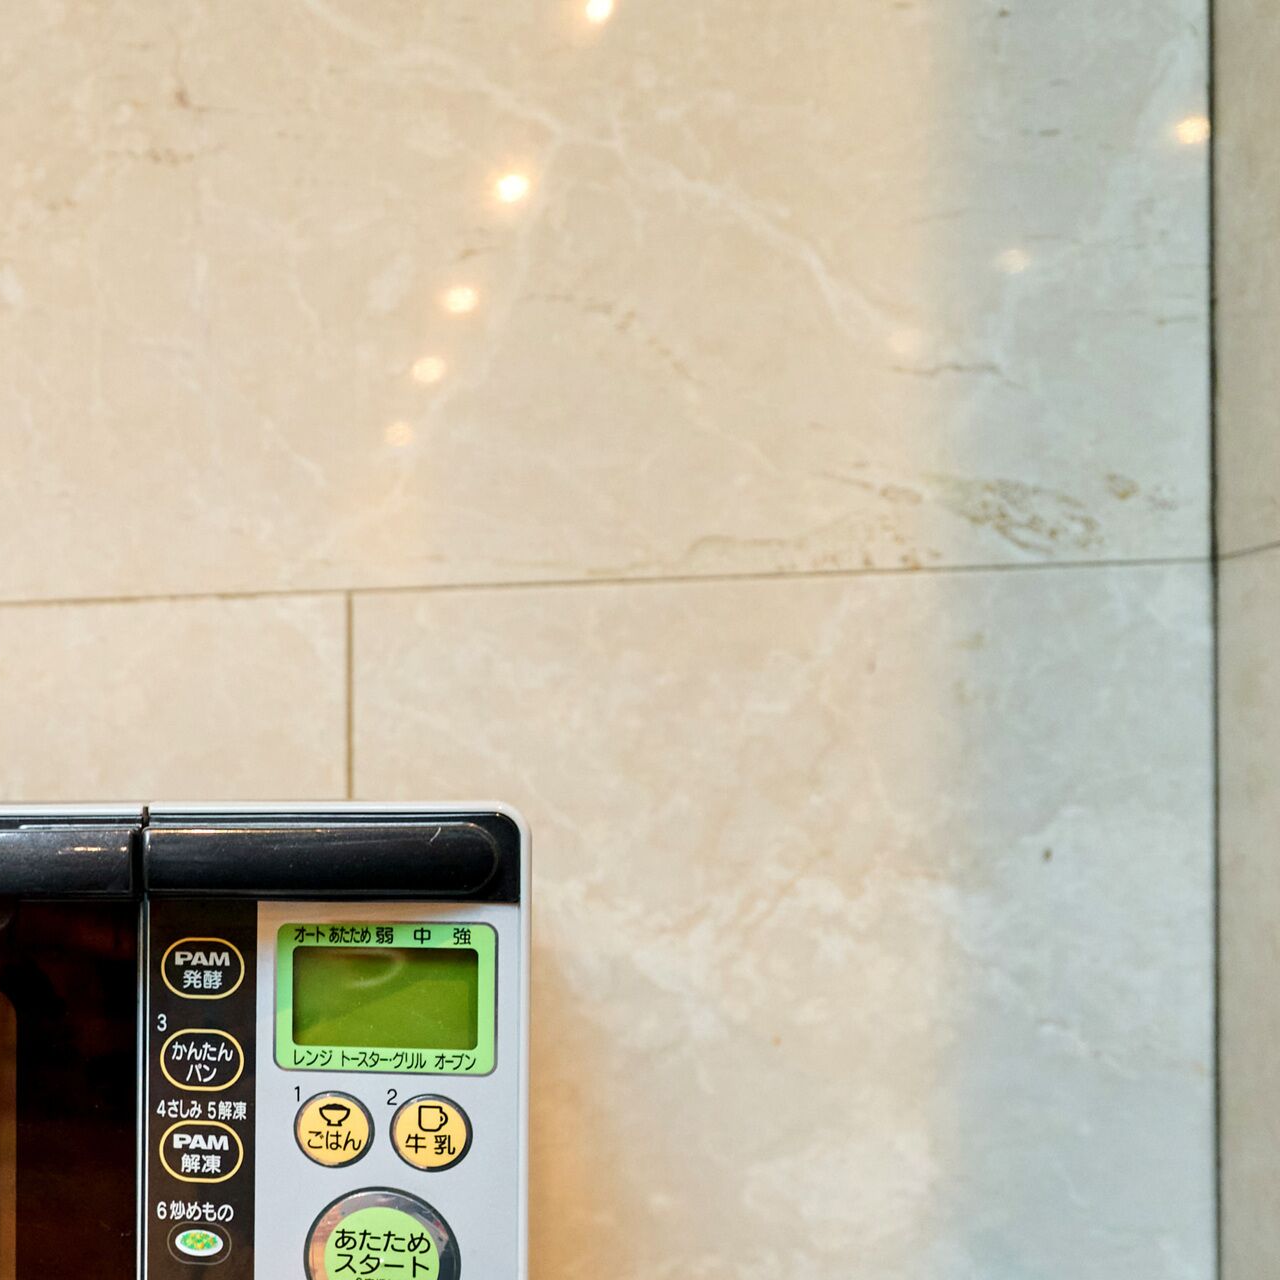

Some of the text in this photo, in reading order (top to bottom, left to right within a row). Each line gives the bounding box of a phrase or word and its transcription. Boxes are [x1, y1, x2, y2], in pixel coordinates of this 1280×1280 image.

[294, 927, 472, 945] オート あたため 弱 中 強
[175, 951, 230, 967] PAM
[182, 970, 223, 990] 発酵
[157, 1014, 168, 1032] 3
[171, 1041, 234, 1062] かんたん
[293, 1049, 332, 1067] レンジ
[434, 1054, 477, 1072] オーブン
[186, 1064, 217, 1083] パン
[294, 1086, 301, 1102] 1
[387, 1089, 398, 1106] 2
[173, 1134, 229, 1151] PAM
[307, 1130, 362, 1151] ごはん
[405, 1133, 457, 1156] 牛乳
[181, 1153, 222, 1174] 解凍
[334, 1228, 432, 1254] あたため
[334, 1253, 431, 1279] スタート
